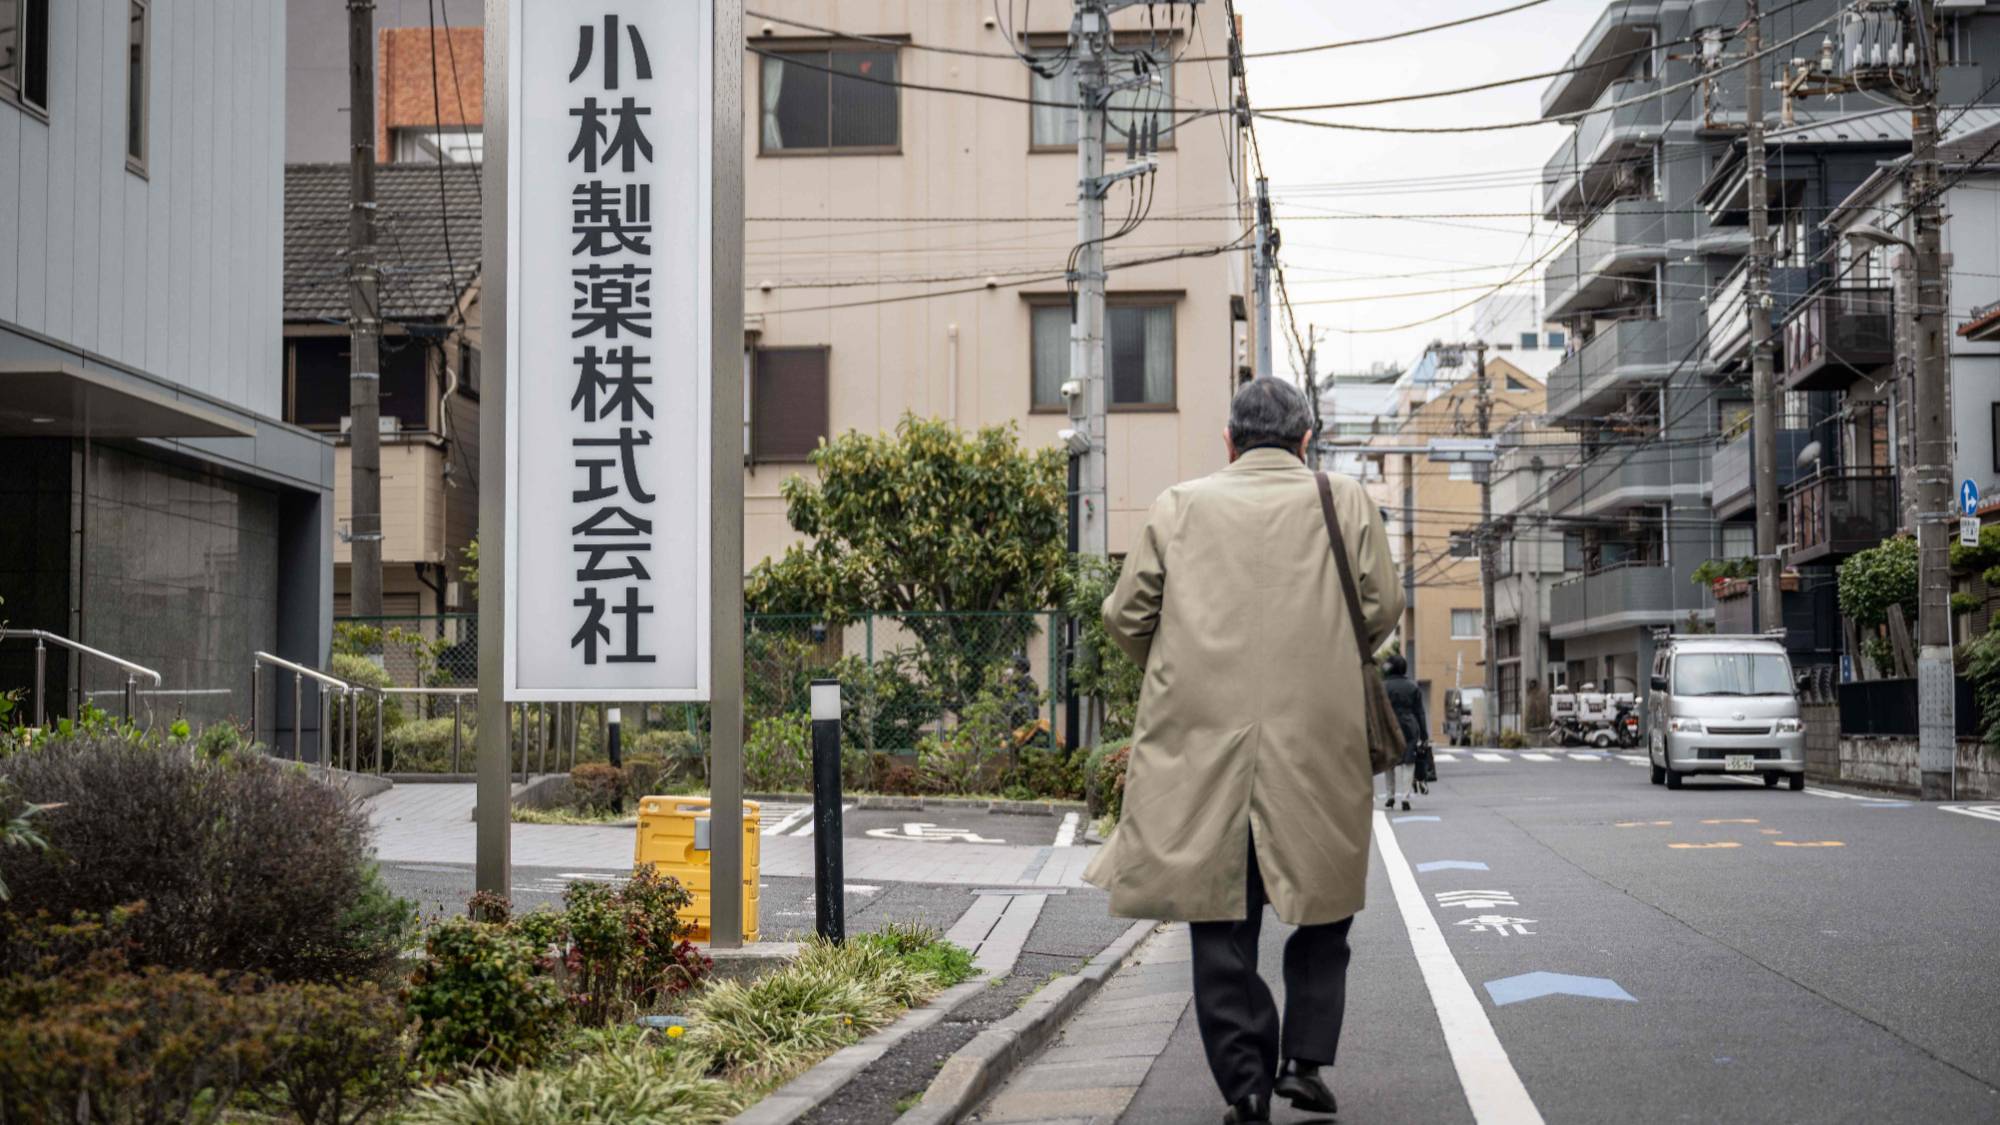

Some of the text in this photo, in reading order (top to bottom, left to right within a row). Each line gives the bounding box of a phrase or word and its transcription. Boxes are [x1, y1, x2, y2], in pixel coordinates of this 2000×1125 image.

[568, 14, 657, 664] 小林製薬株式会社
